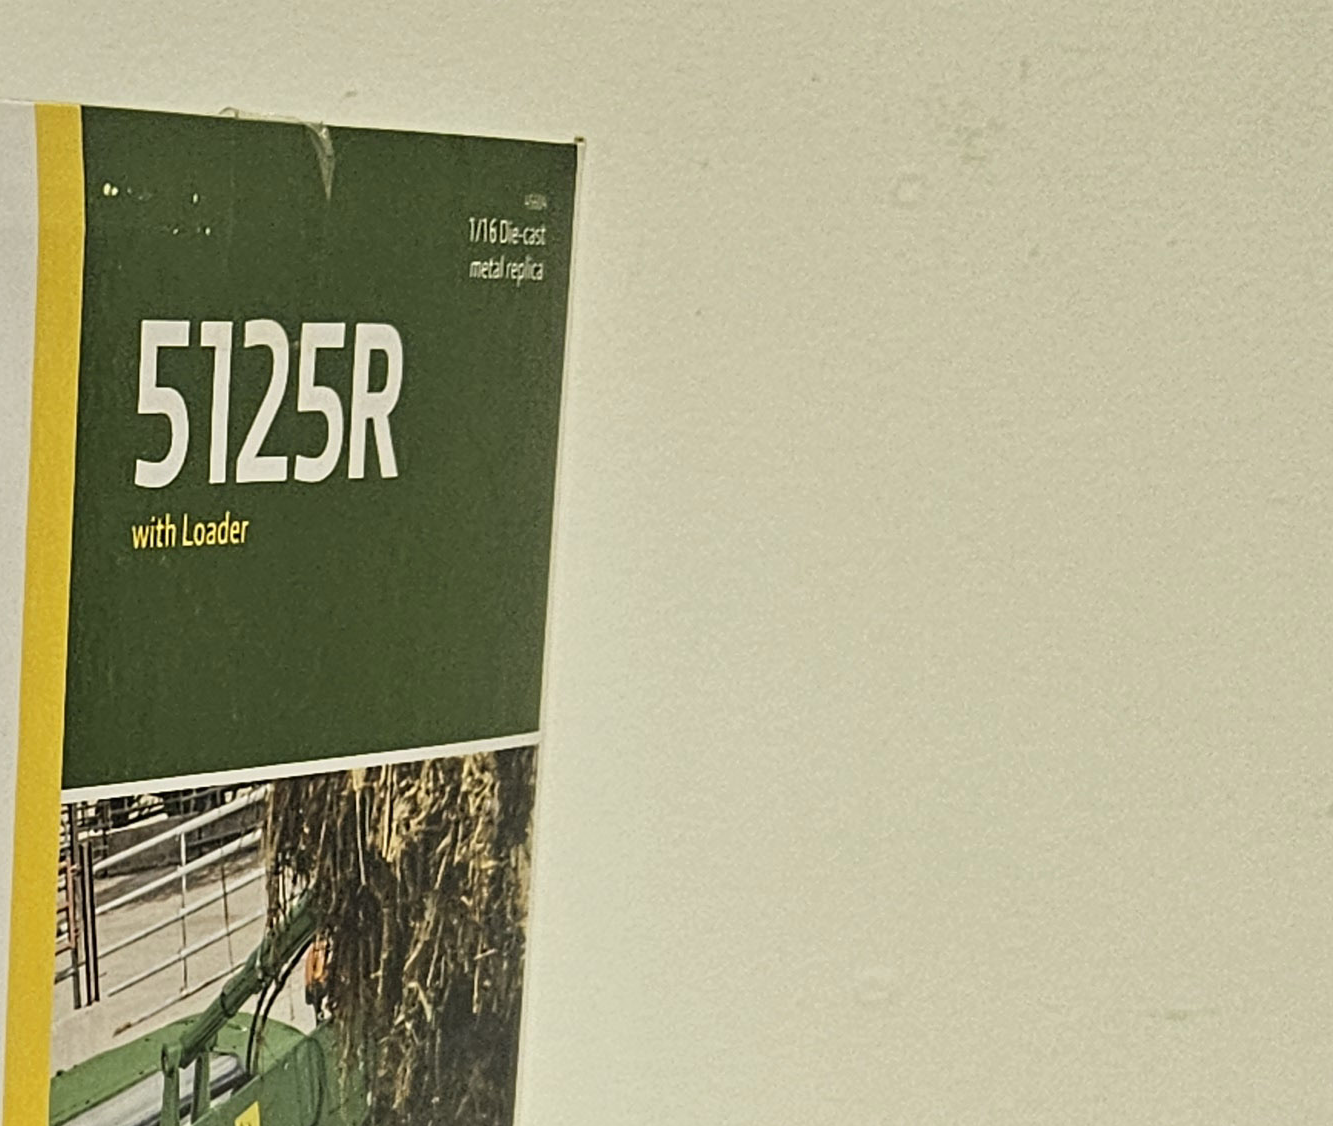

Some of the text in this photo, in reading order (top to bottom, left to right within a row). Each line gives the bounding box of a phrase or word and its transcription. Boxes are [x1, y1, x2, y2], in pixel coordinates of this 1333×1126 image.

[469, 217, 546, 245] 1/16 Die-cast
[469, 255, 543, 287] metal replica
[134, 319, 403, 488] 5125R
[132, 511, 249, 549] with Loader
